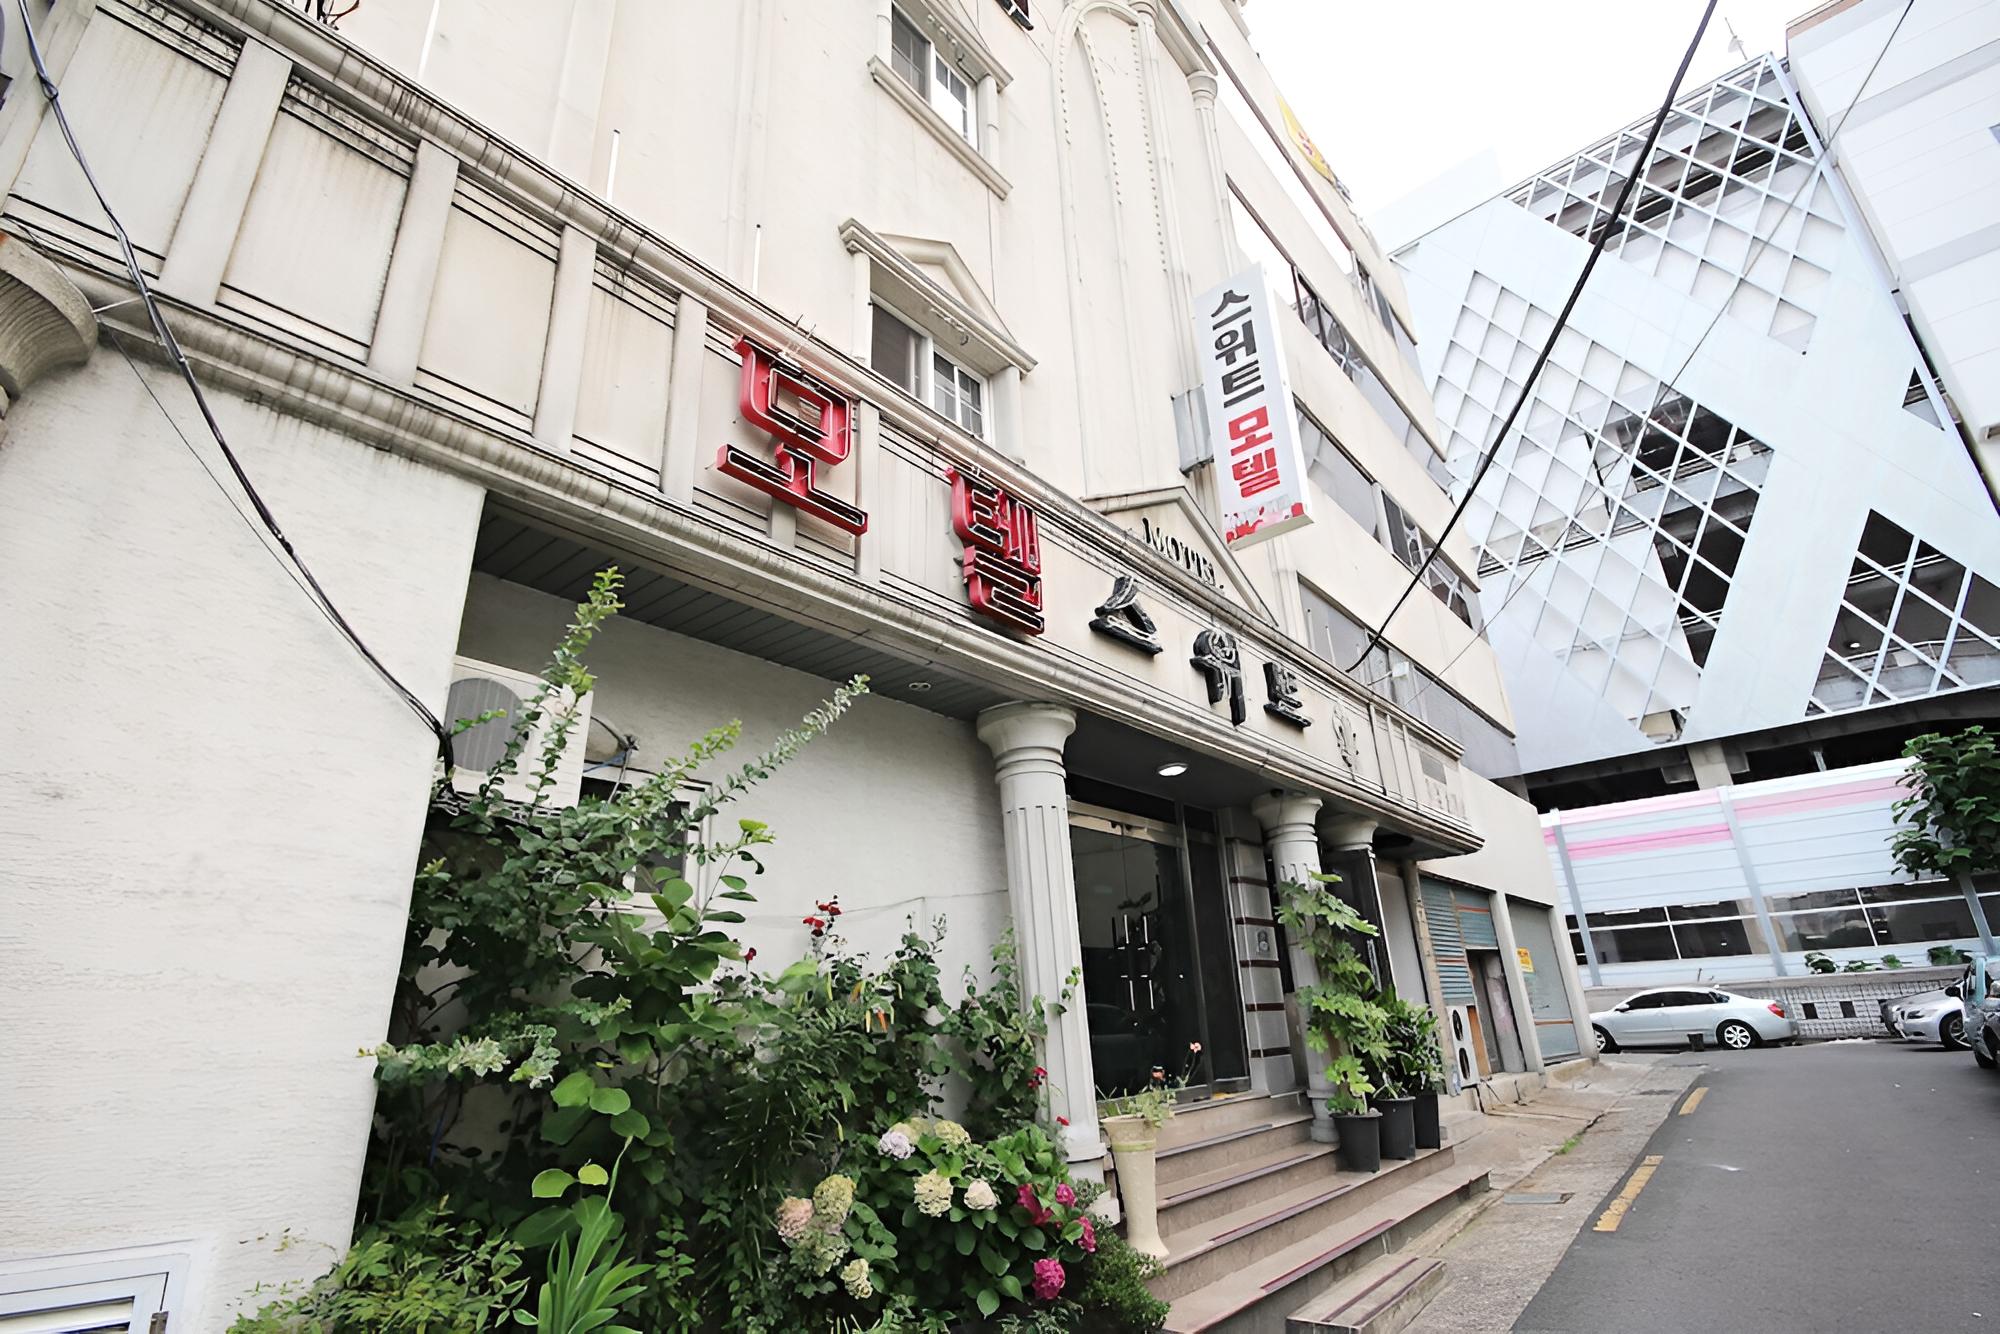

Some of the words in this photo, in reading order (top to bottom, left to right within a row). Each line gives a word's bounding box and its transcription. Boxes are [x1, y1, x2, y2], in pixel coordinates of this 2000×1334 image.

[716, 334, 1045, 636] 모텔
[1088, 575, 1312, 728] 스위트
[1228, 405, 1281, 498] 모텔
